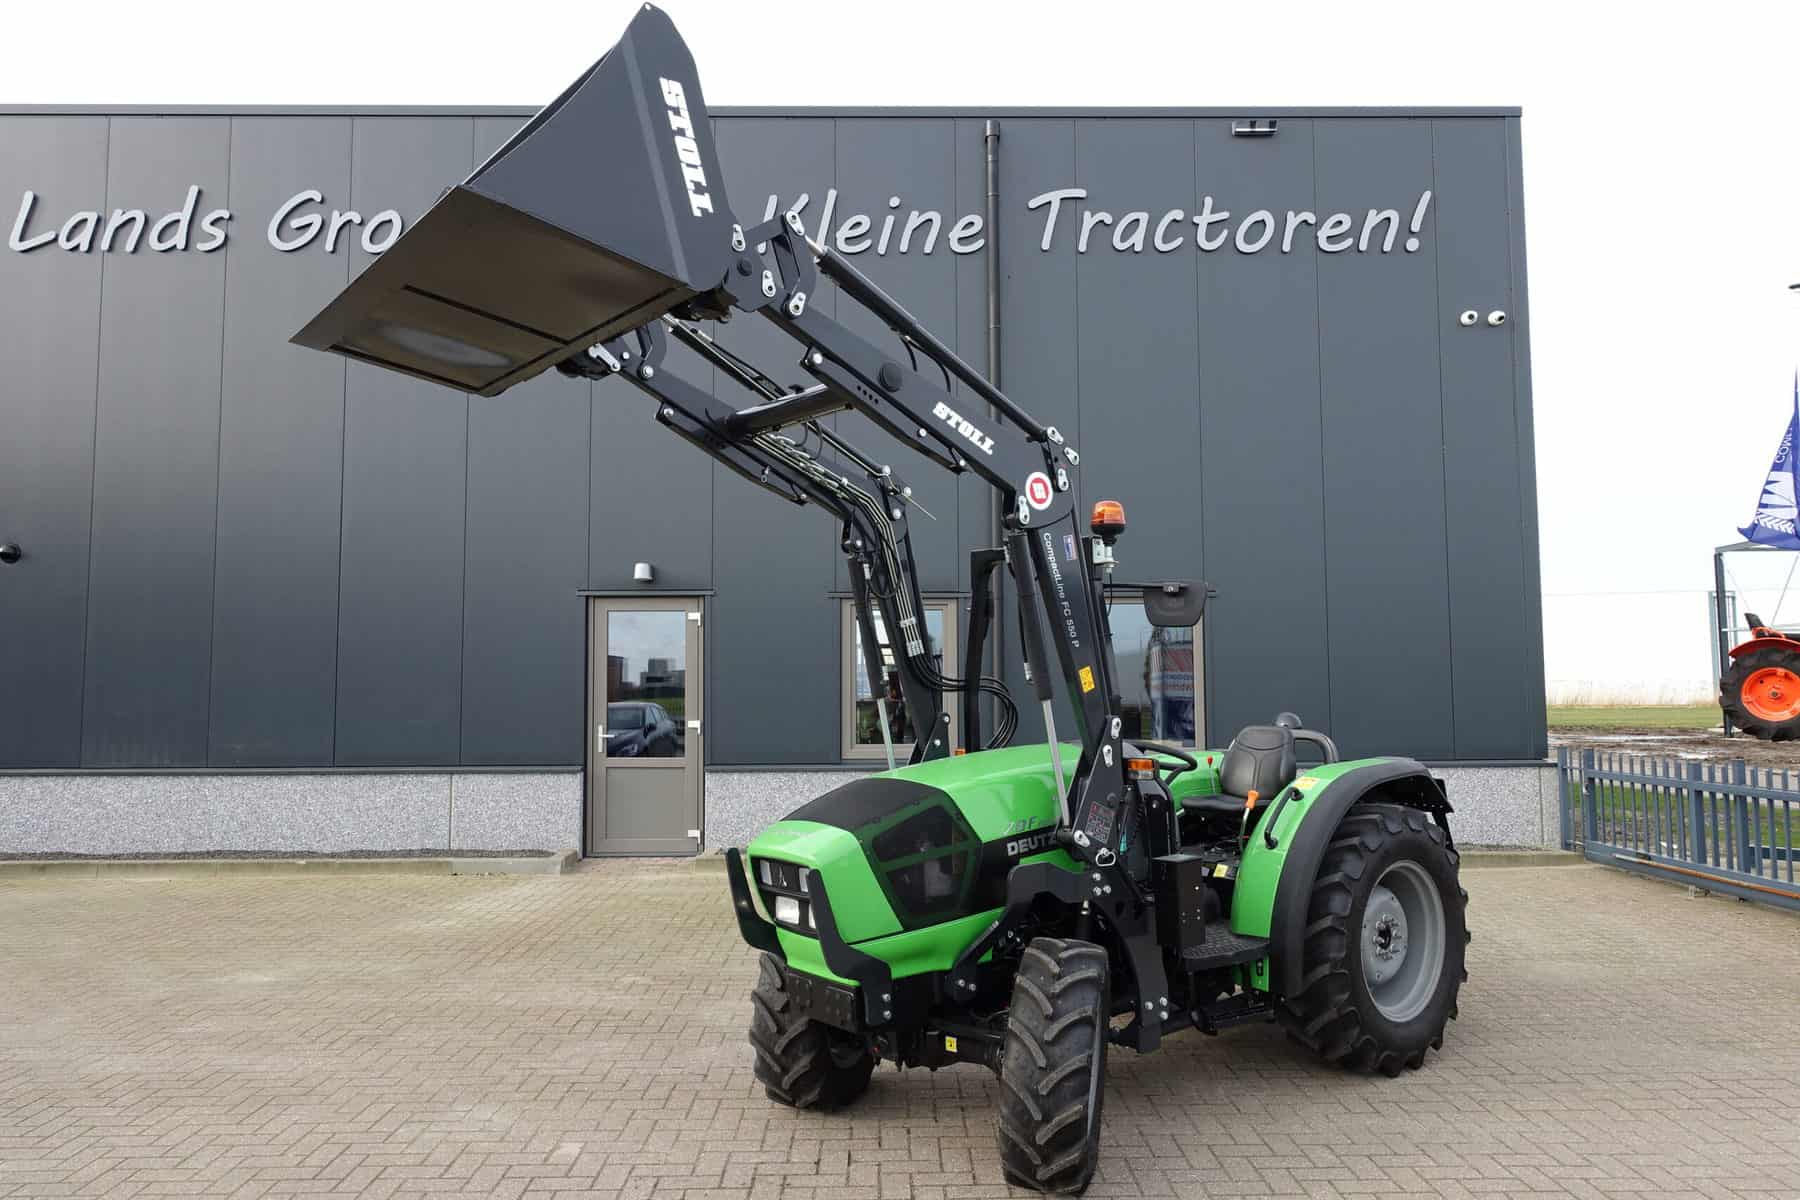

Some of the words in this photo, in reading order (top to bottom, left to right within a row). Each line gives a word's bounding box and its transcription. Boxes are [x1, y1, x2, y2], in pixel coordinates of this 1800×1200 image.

[659, 77, 714, 217] STOLL
[8, 185, 231, 252] Lands
[267, 190, 403, 254] Gro
[757, 188, 985, 261] Kleine
[1027, 188, 1432, 254] Tractoren!
[932, 401, 995, 455] STOLL
[1043, 532, 1065, 599] CompactLine
